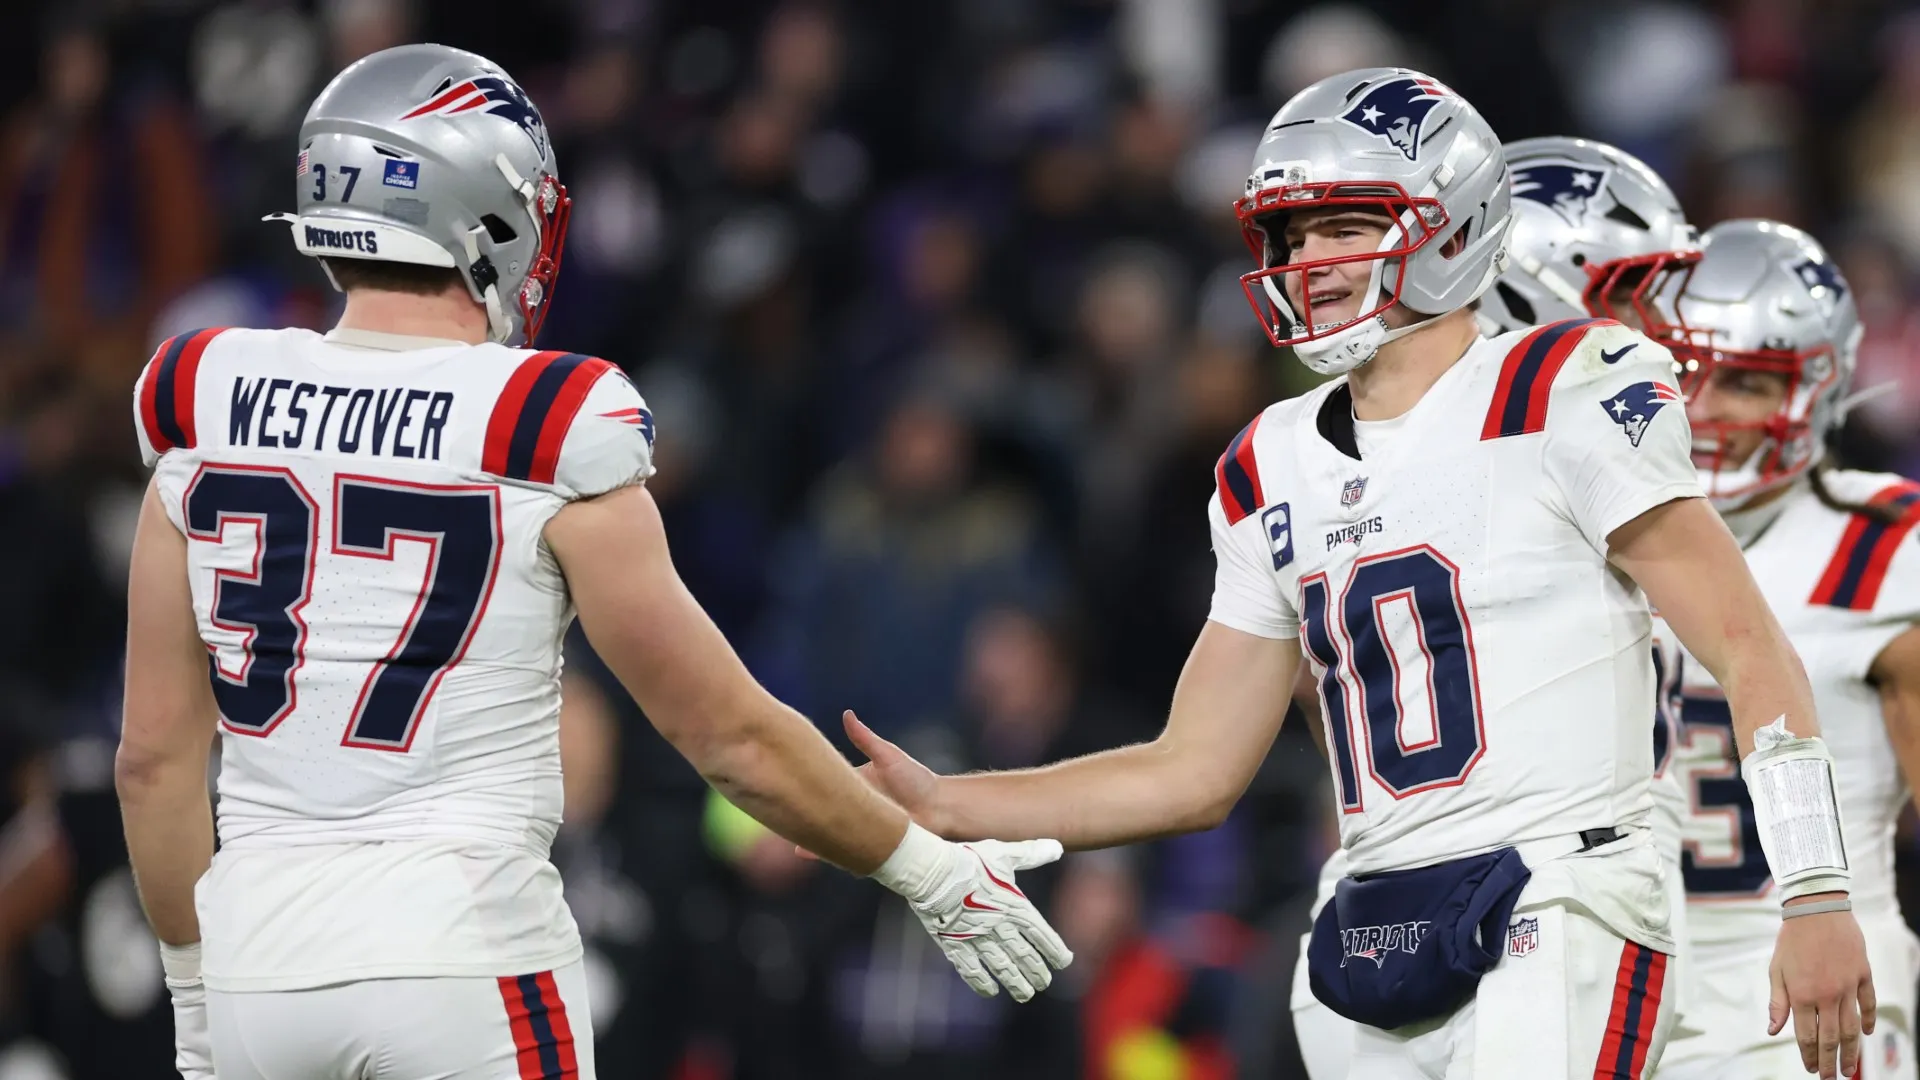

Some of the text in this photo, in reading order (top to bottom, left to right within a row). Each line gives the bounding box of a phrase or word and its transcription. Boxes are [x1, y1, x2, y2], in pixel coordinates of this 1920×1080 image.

[312, 163, 361, 203] 37
[304, 224, 378, 254] PATRIOTS
[229, 376, 454, 461] WESTOVER
[1264, 508, 1289, 556] C
[1326, 516, 1383, 552] PATRIOTS
[183, 461, 504, 753] 37
[1300, 543, 1487, 815] 10
[1511, 933, 1536, 954] NFL
